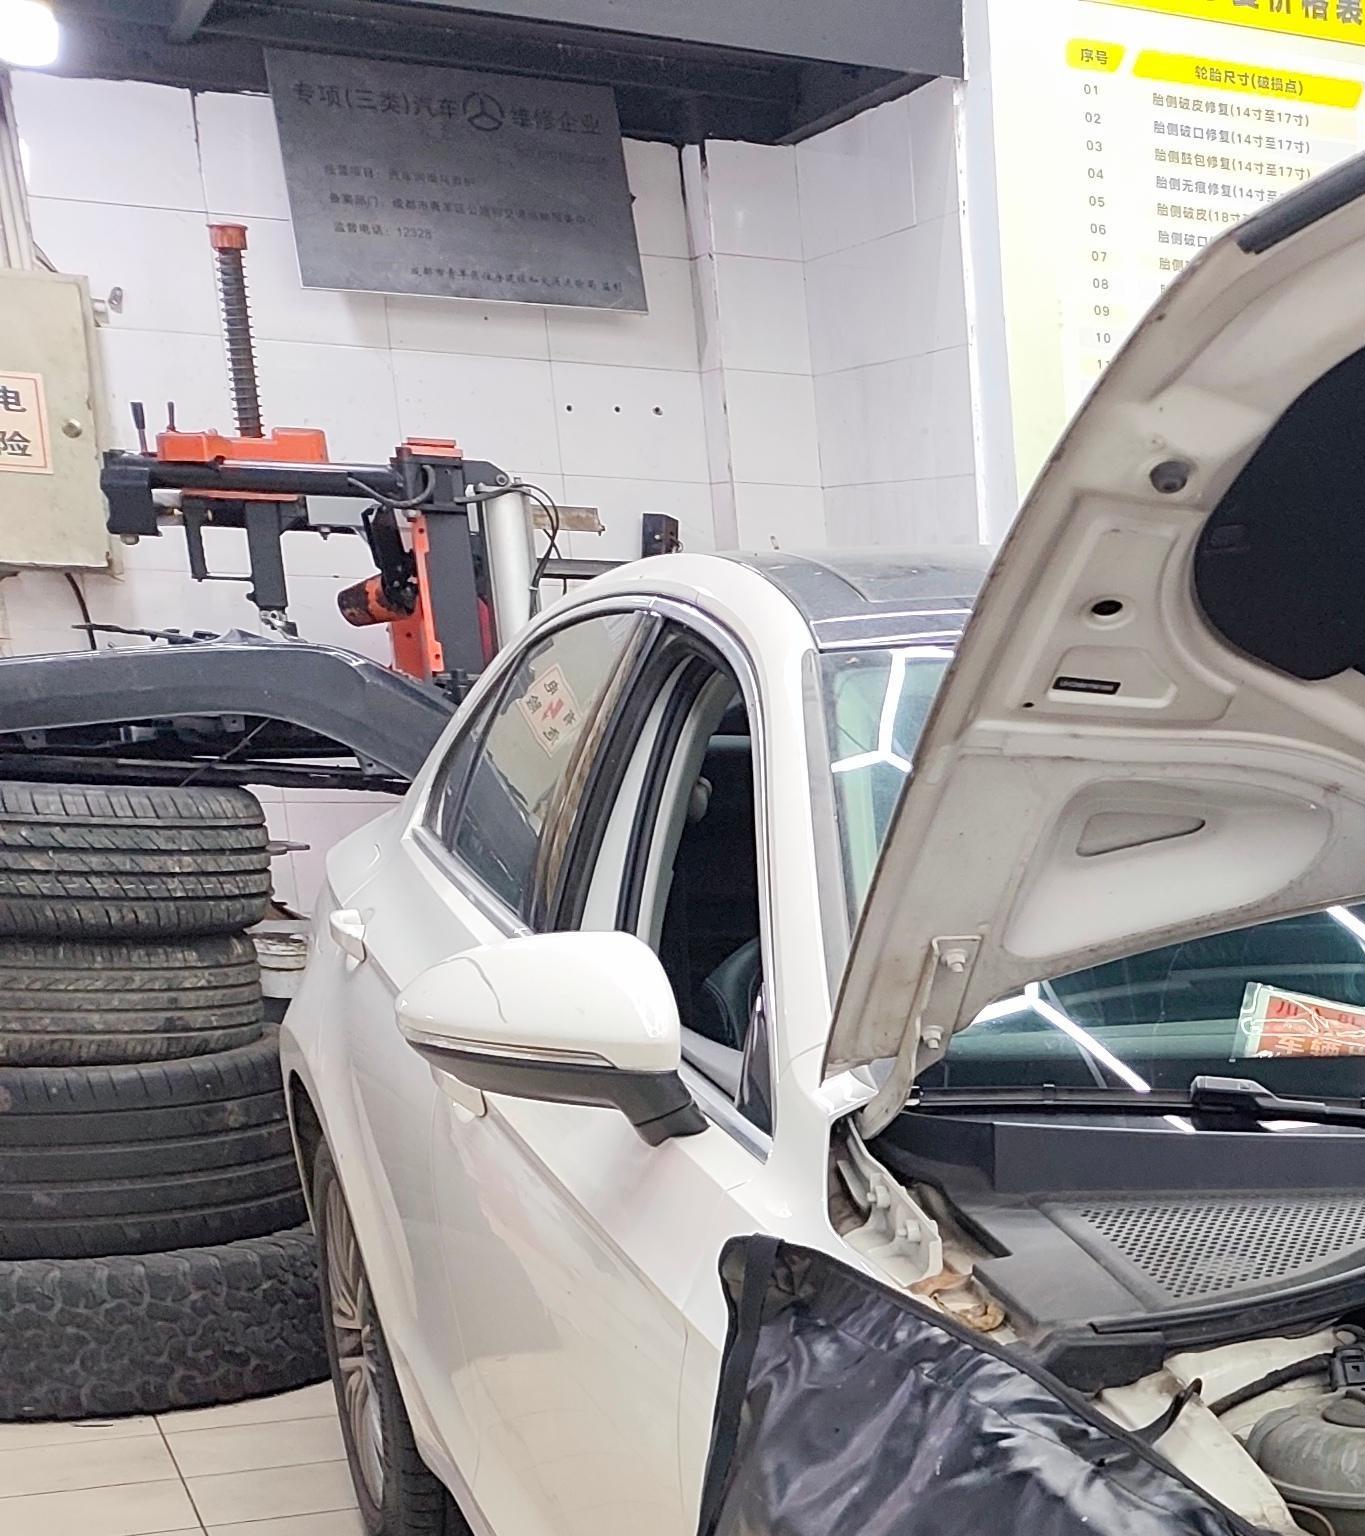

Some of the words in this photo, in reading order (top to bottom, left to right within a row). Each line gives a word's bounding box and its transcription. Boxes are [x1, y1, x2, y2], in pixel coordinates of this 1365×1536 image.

[1081, 48, 1109, 65] 序号
[1195, 65, 1304, 96] 轮胎尺寸(破损点)
[1084, 84, 1099, 95] 01
[1152, 92, 1310, 128] 胎侧破皮修复(14寸至17寸)
[1085, 112, 1101, 124] 02
[1153, 120, 1311, 155] 胎侧破口修复(14寸至17寸)
[1086, 140, 1103, 152] 03
[1087, 167, 1104, 180] 04
[1155, 175, 1284, 203] 胎侧无痕修复(14寸至
[1088, 196, 1105, 208] 05
[1090, 223, 1107, 235] 06
[1091, 251, 1107, 263] 07
[1092, 278, 1109, 290] 08
[1094, 305, 1110, 317] 09
[1096, 333, 1111, 344] 10
